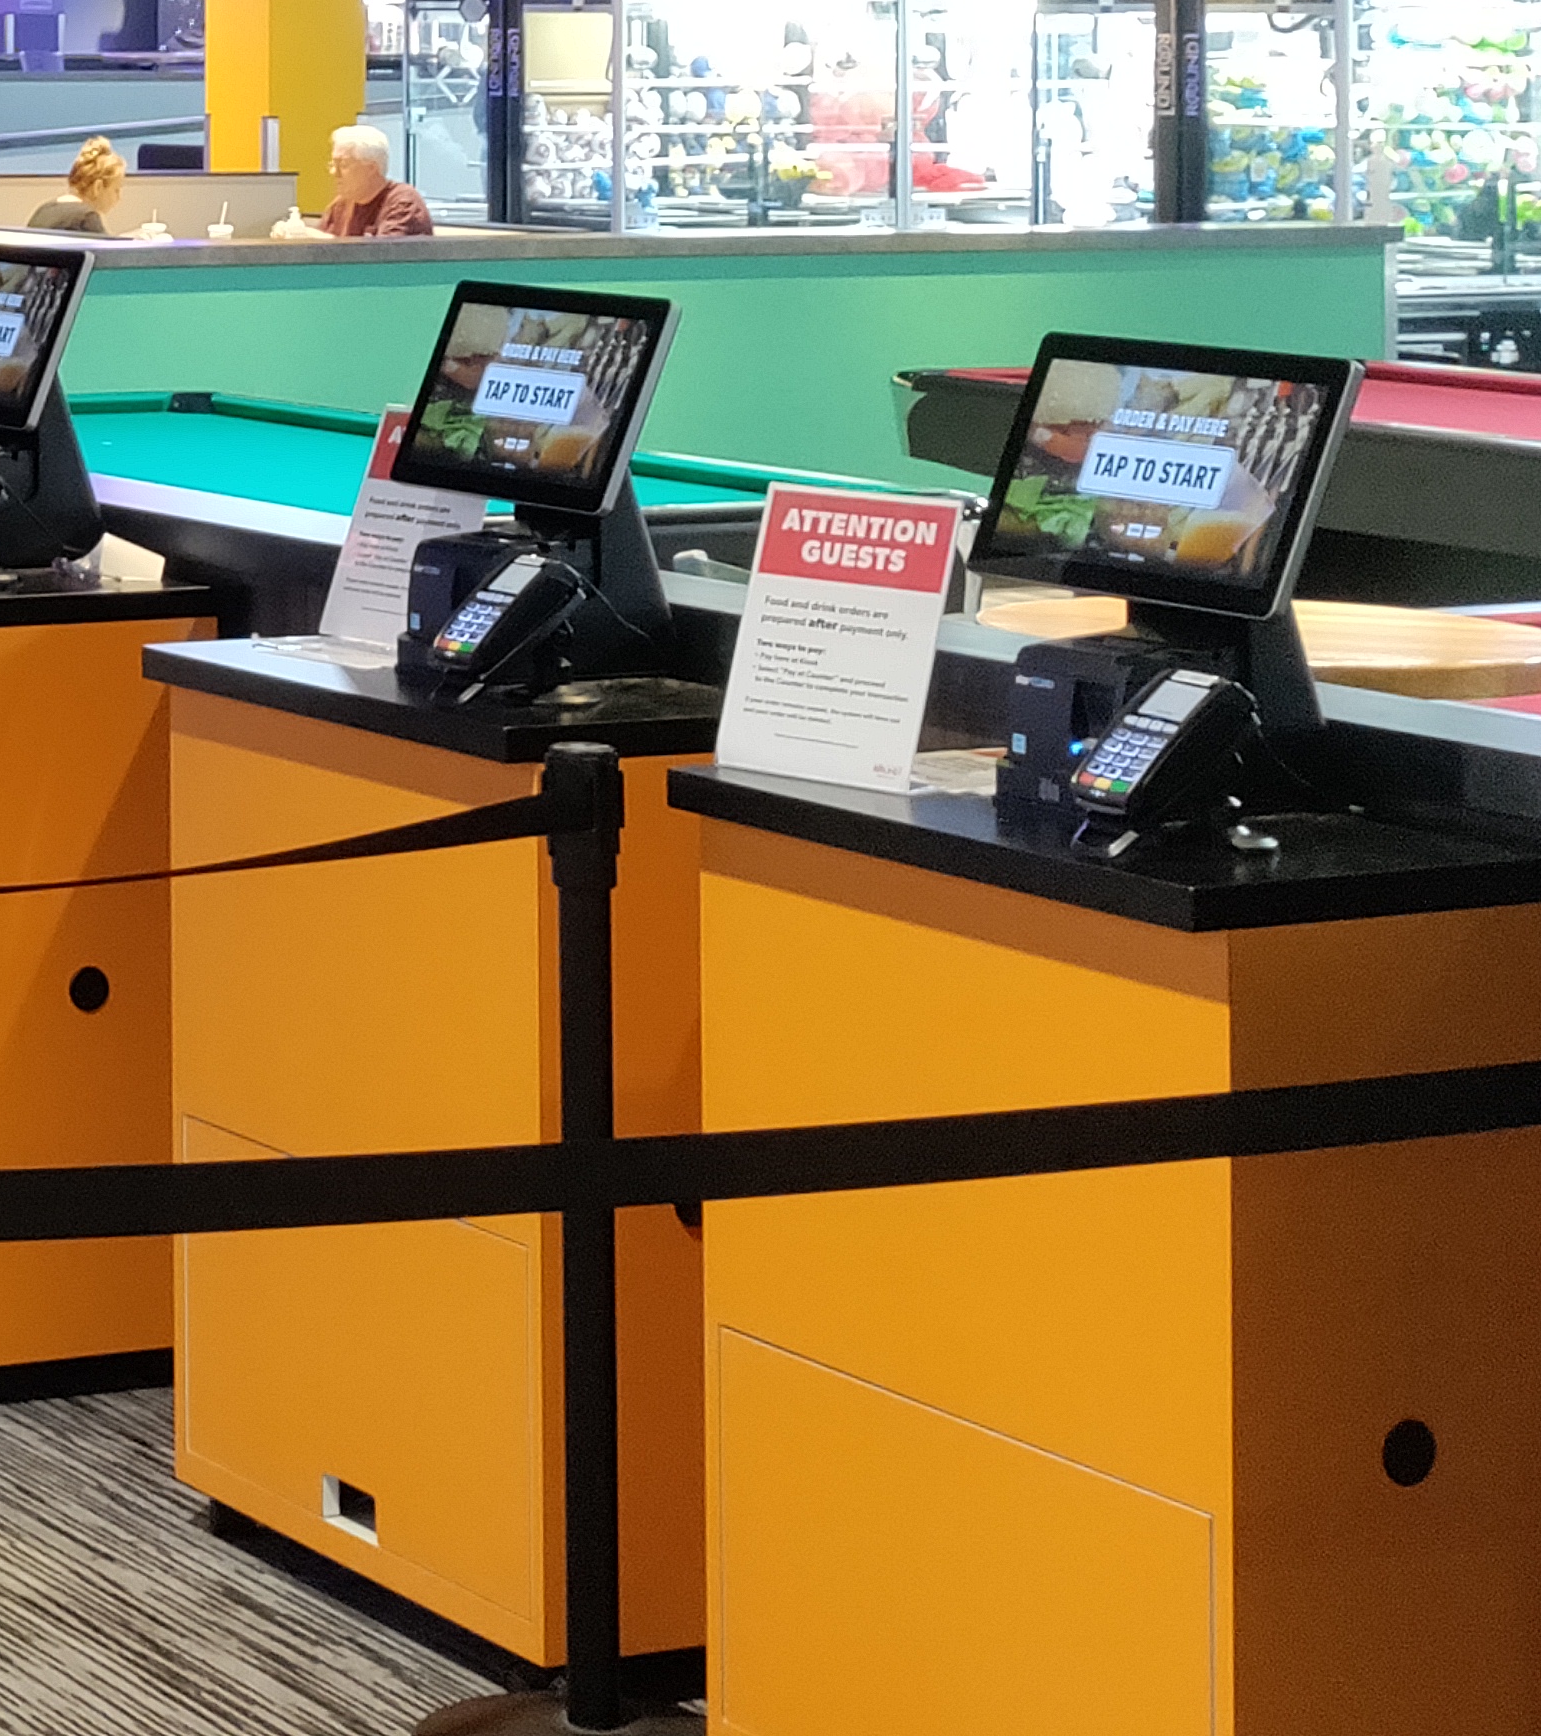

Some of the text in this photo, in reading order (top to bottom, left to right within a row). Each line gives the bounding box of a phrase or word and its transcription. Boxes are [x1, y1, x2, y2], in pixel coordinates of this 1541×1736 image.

[1157, 33, 1175, 116] ROUND1
[1183, 33, 1200, 116] ROUND1
[502, 343, 532, 360] ORDER
[540, 348, 557, 363] PAY
[486, 380, 575, 410] TAP TO START
[1114, 408, 1230, 438] ORDER & PAY HERE
[1093, 453, 1221, 491] TAP TO START
[782, 507, 938, 545] ATTENTION
[801, 539, 907, 572] GUESTS
[765, 595, 888, 619] Food and drink orders are
[761, 614, 908, 641] prepared after payment only.
[757, 638, 773, 648] Two
[775, 641, 796, 652] ways
